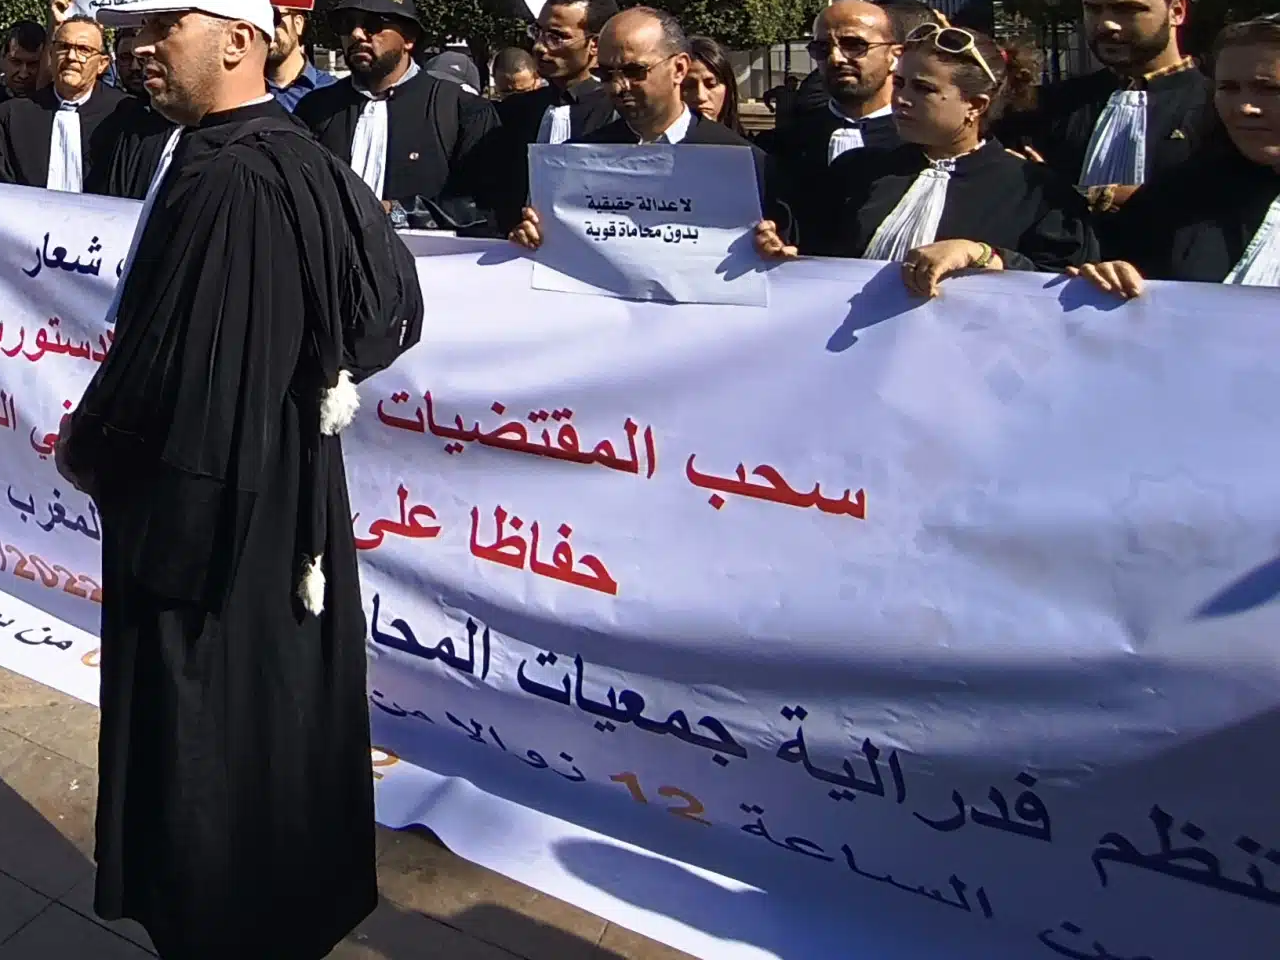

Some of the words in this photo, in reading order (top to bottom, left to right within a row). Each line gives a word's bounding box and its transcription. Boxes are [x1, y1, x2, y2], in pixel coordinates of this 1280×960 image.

[586, 195, 635, 214] حقيقية
[636, 196, 678, 212] عدالة
[679, 197, 692, 212] لا
[22, 231, 102, 278] شعار
[585, 221, 616, 241] قوية
[618, 221, 662, 239] محاماة
[663, 225, 699, 244] بدون
[376, 389, 656, 480] المقتضيات
[686, 452, 866, 520] سحب
[7, 488, 102, 541] لمغرب
[352, 483, 442, 550] على
[470, 504, 619, 596] حفاظا
[14, 627, 73, 651] من
[371, 592, 490, 680] المحا
[369, 689, 436, 724] من
[517, 650, 748, 767] جمعيات
[610, 771, 713, 826] 12
[740, 803, 994, 919] الساعة
